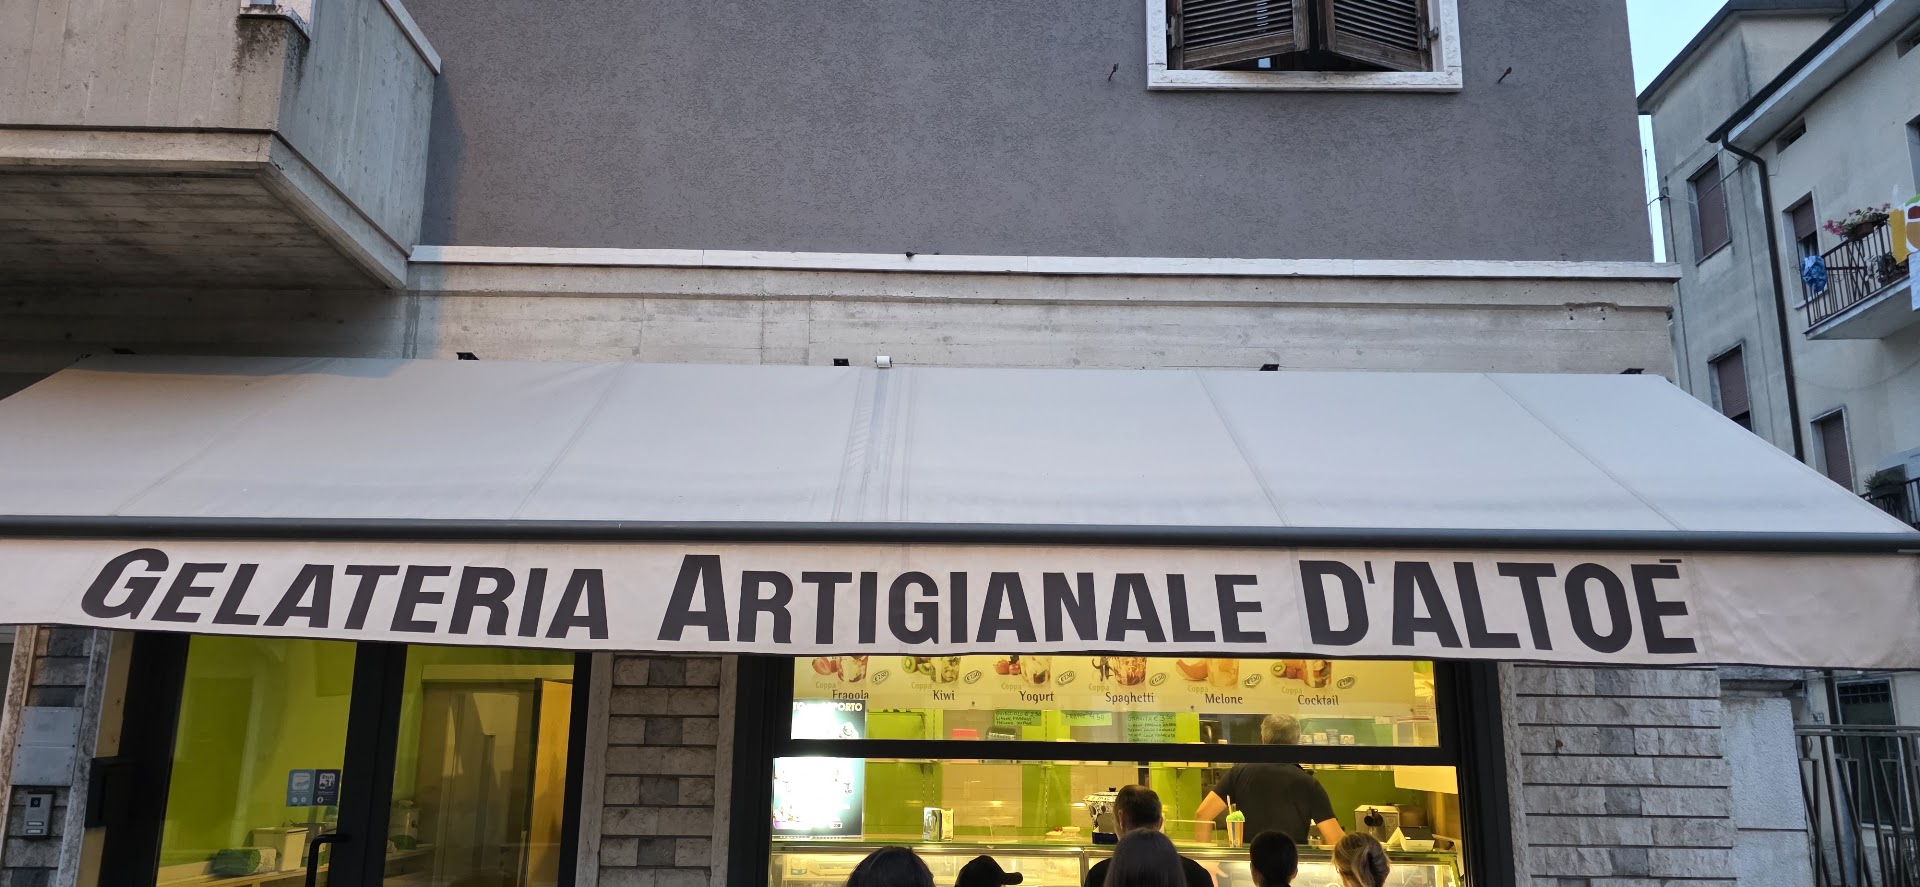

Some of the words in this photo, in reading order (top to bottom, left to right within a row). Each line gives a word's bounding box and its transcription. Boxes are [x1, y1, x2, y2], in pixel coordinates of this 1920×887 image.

[81, 547, 609, 640] GELATERIA
[656, 554, 1267, 645] ARTIGIANALE
[815, 681, 836, 690] Coppa
[911, 681, 932, 690] Coppa
[1001, 682, 1022, 691] Coppa
[1088, 683, 1110, 692] Coppa
[1187, 684, 1209, 693] Coppa
[1281, 686, 1302, 694] Coppa
[933, 689, 955, 701] Kiwi
[1019, 690, 1054, 704] Yogurt
[1105, 691, 1155, 706] Spaghetti
[1205, 693, 1243, 704] Melone
[1298, 694, 1339, 706] Cocktail
